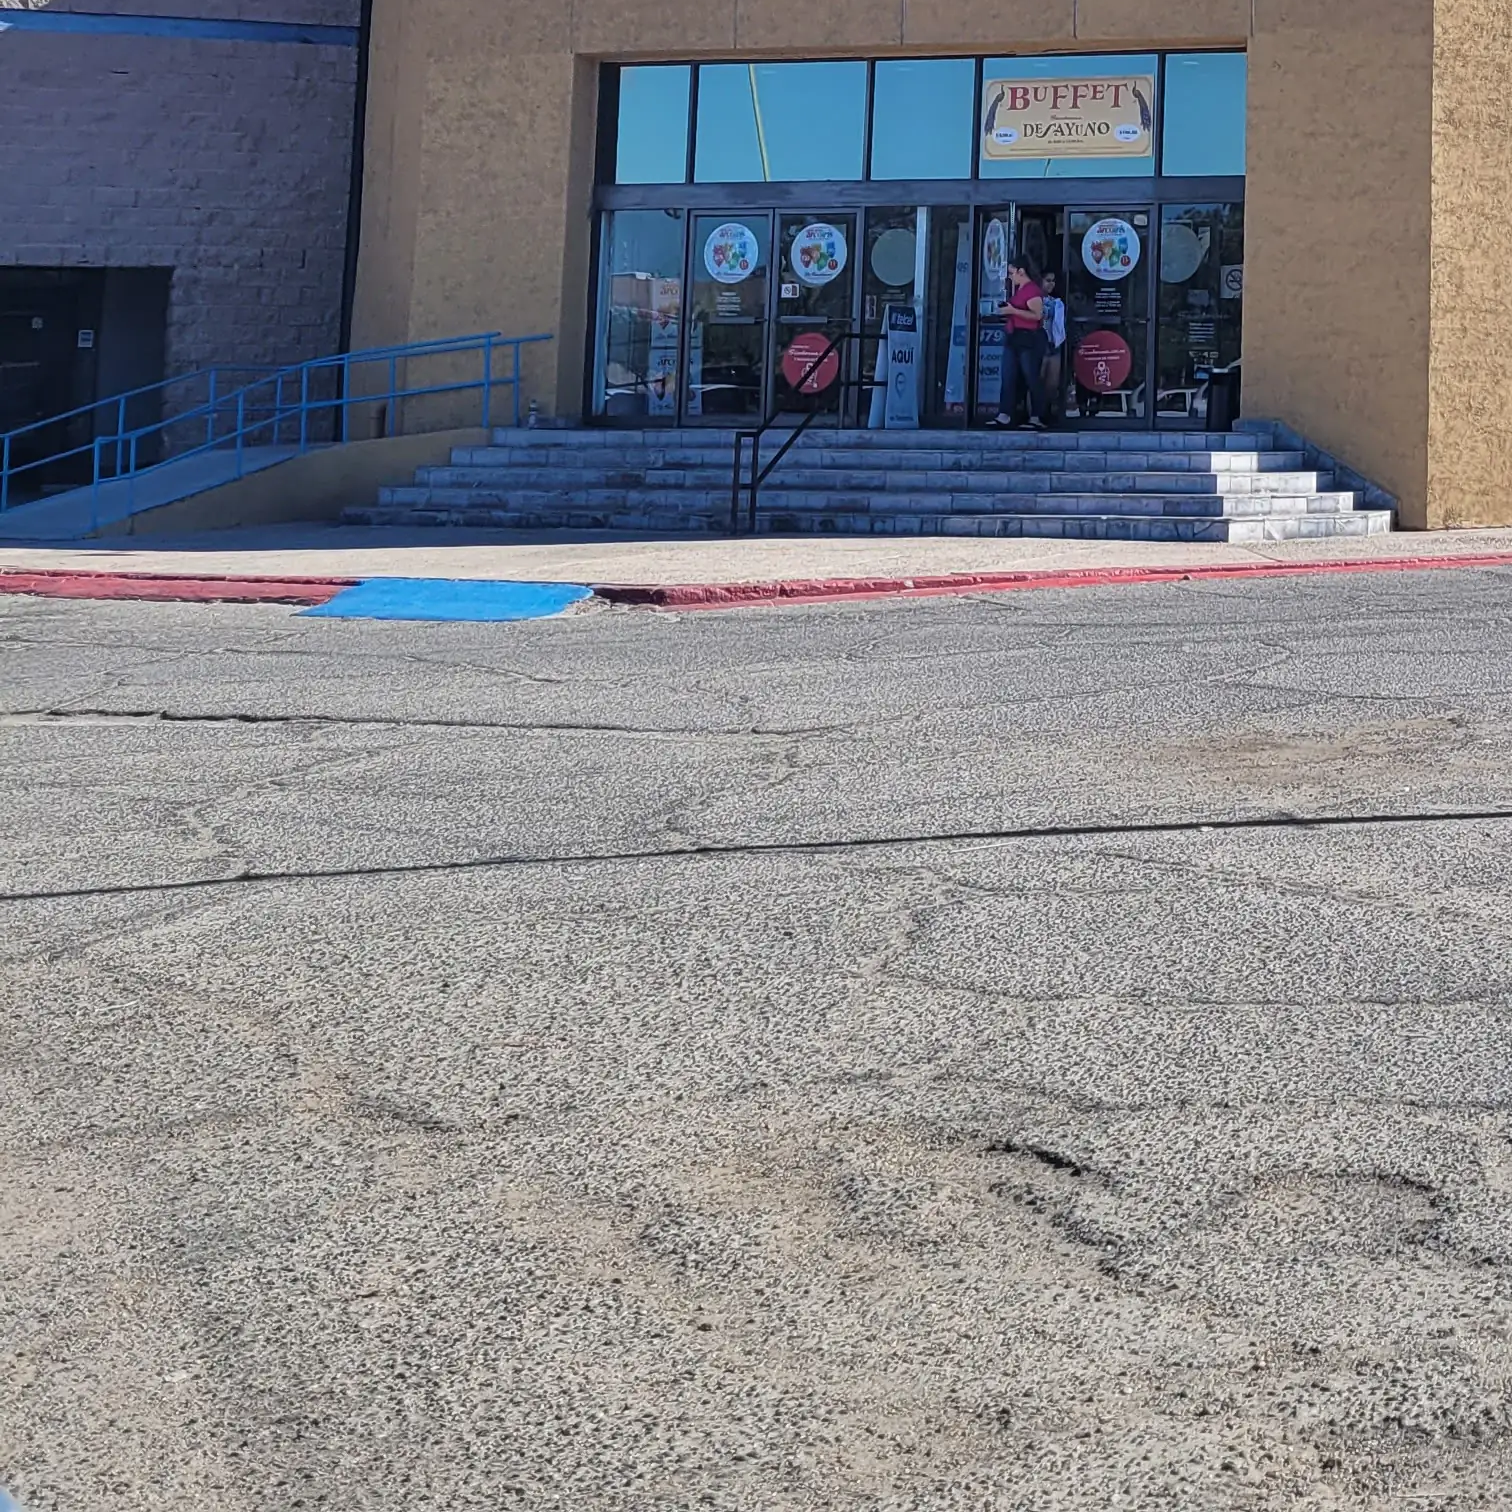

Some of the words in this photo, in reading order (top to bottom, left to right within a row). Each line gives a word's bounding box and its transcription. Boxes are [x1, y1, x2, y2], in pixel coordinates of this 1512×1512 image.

[1007, 83, 1128, 110] BUFFET
[1024, 122, 1110, 138] DESAYUNO
[892, 347, 914, 364] AQUÍ
